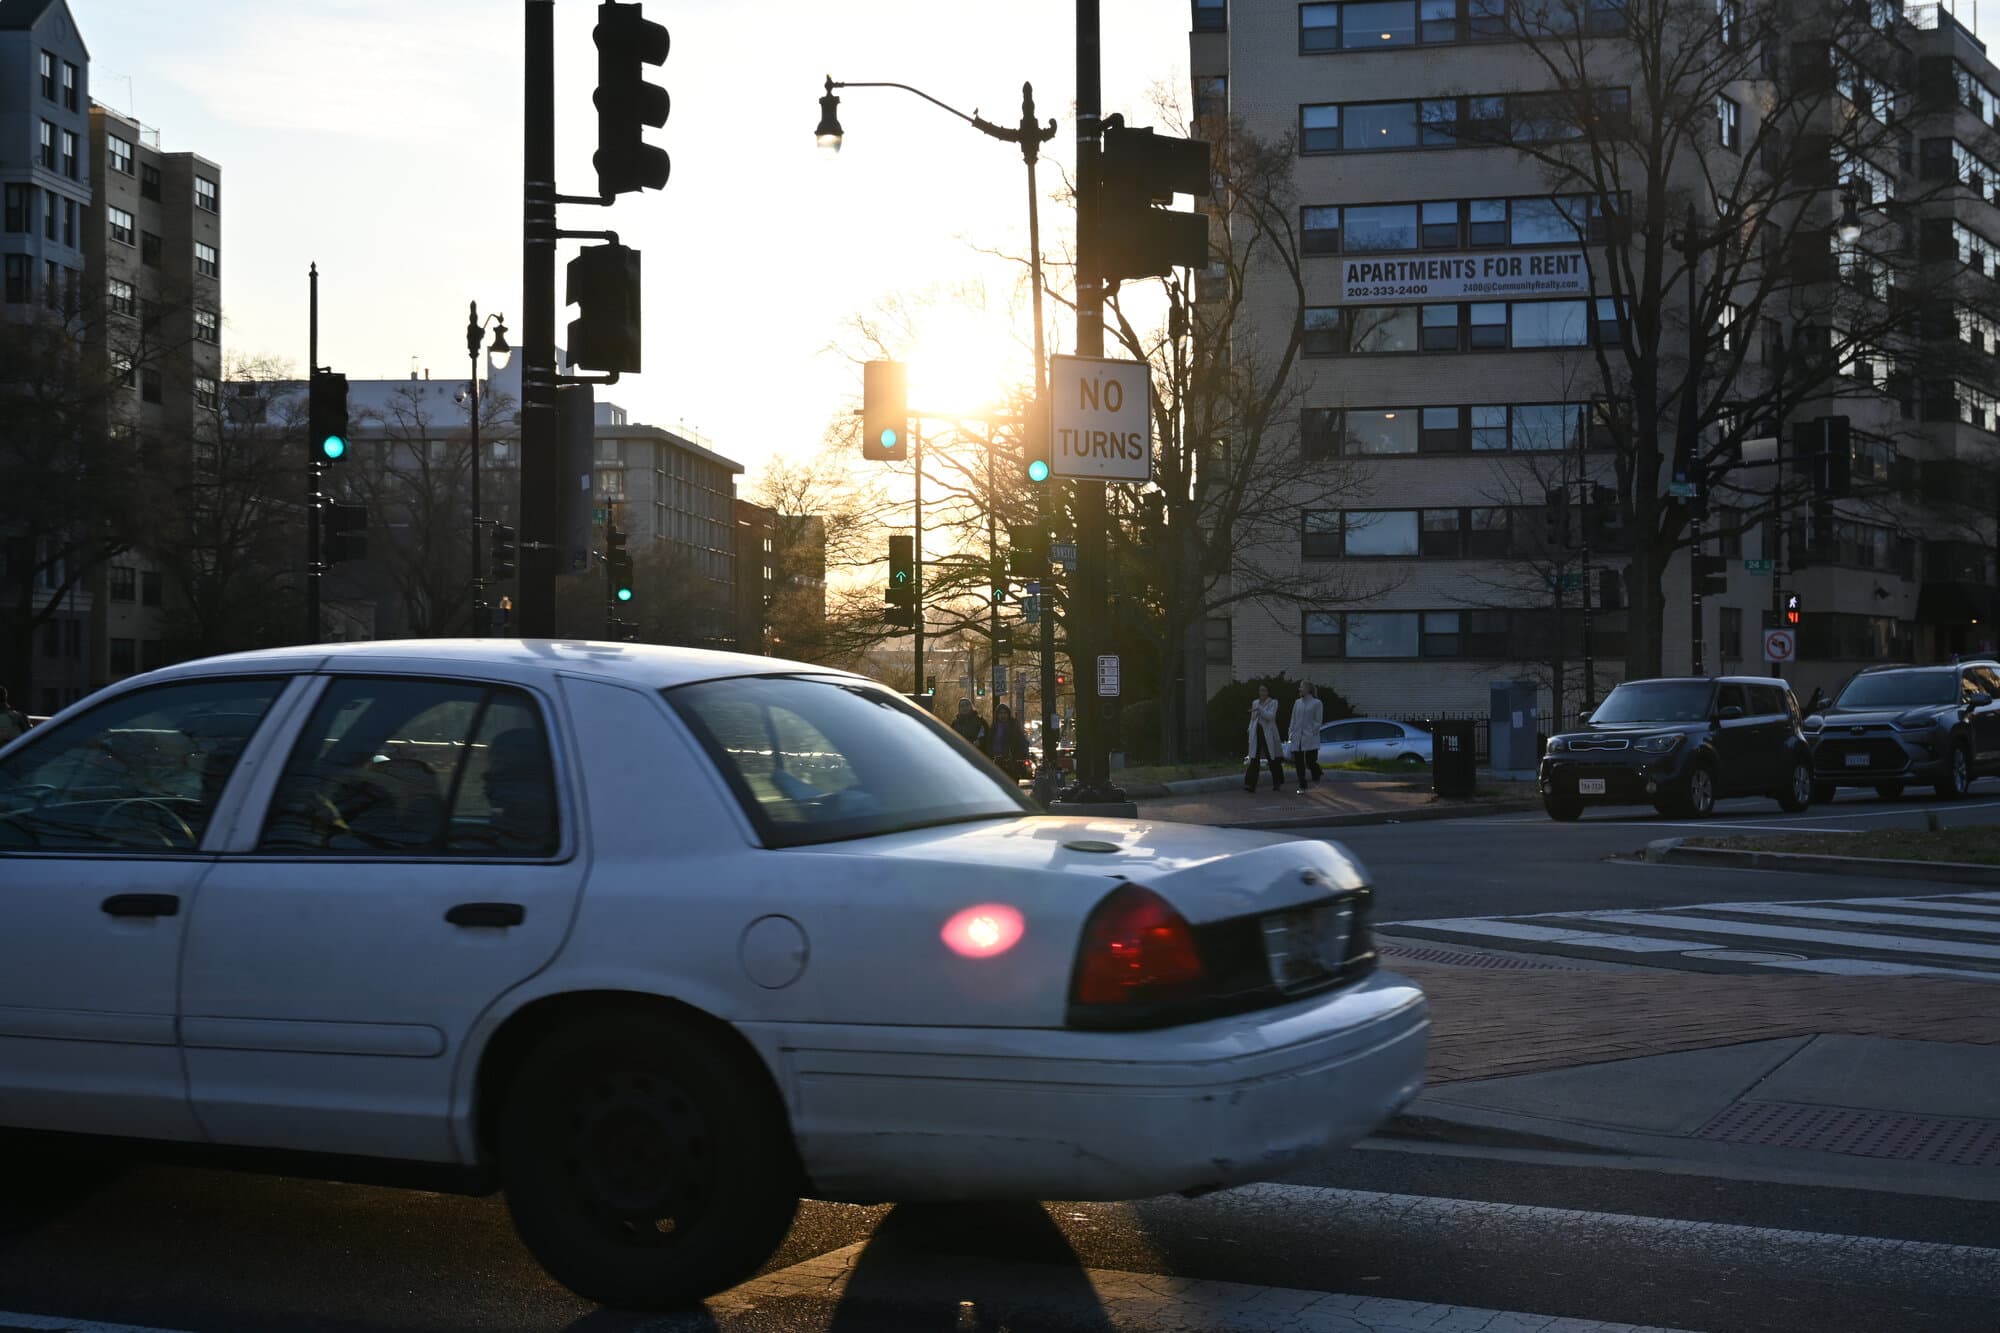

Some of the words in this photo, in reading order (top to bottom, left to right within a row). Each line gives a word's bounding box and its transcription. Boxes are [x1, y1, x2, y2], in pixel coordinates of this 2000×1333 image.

[1347, 259, 1476, 283] APARTMENTS
[1483, 256, 1522, 278] FOR
[1529, 254, 1581, 276] RENT
[1347, 285, 1428, 297] 202-333-2400
[1463, 280, 1579, 293] 2400@CommunityRealty.com
[1080, 377, 1123, 412] NO
[1058, 429, 1143, 460] TURNS
